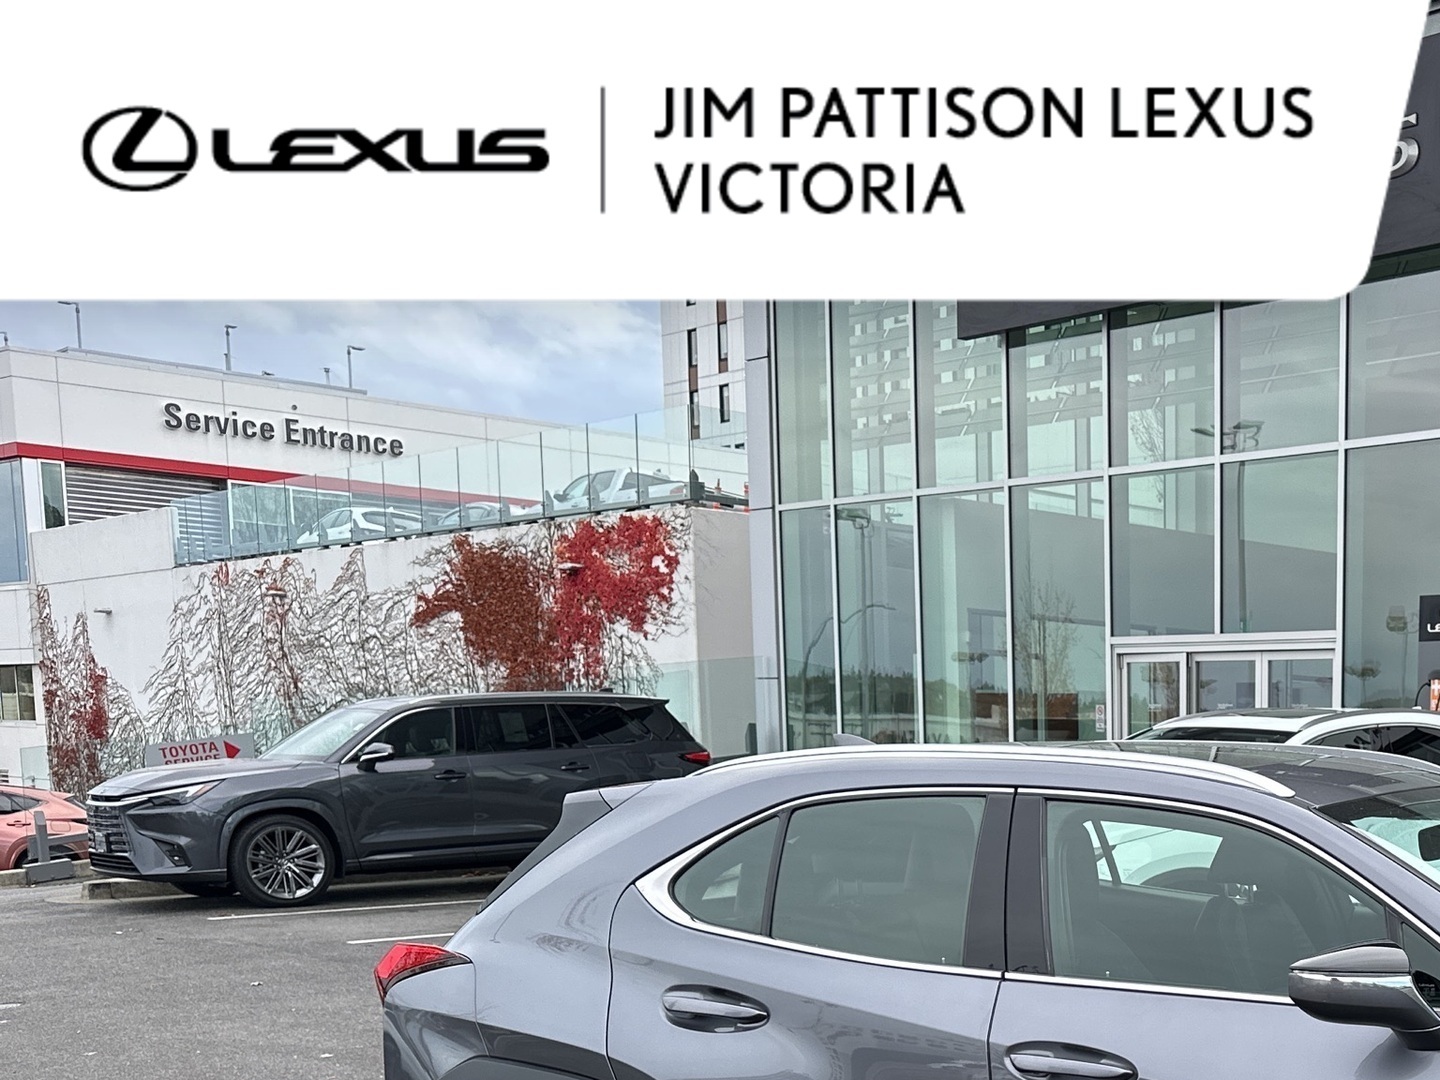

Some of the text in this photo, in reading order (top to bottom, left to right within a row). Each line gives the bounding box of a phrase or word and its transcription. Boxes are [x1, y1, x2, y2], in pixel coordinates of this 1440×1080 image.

[164, 403, 404, 456] Service Entrance
[158, 741, 219, 759] TOYOTA
